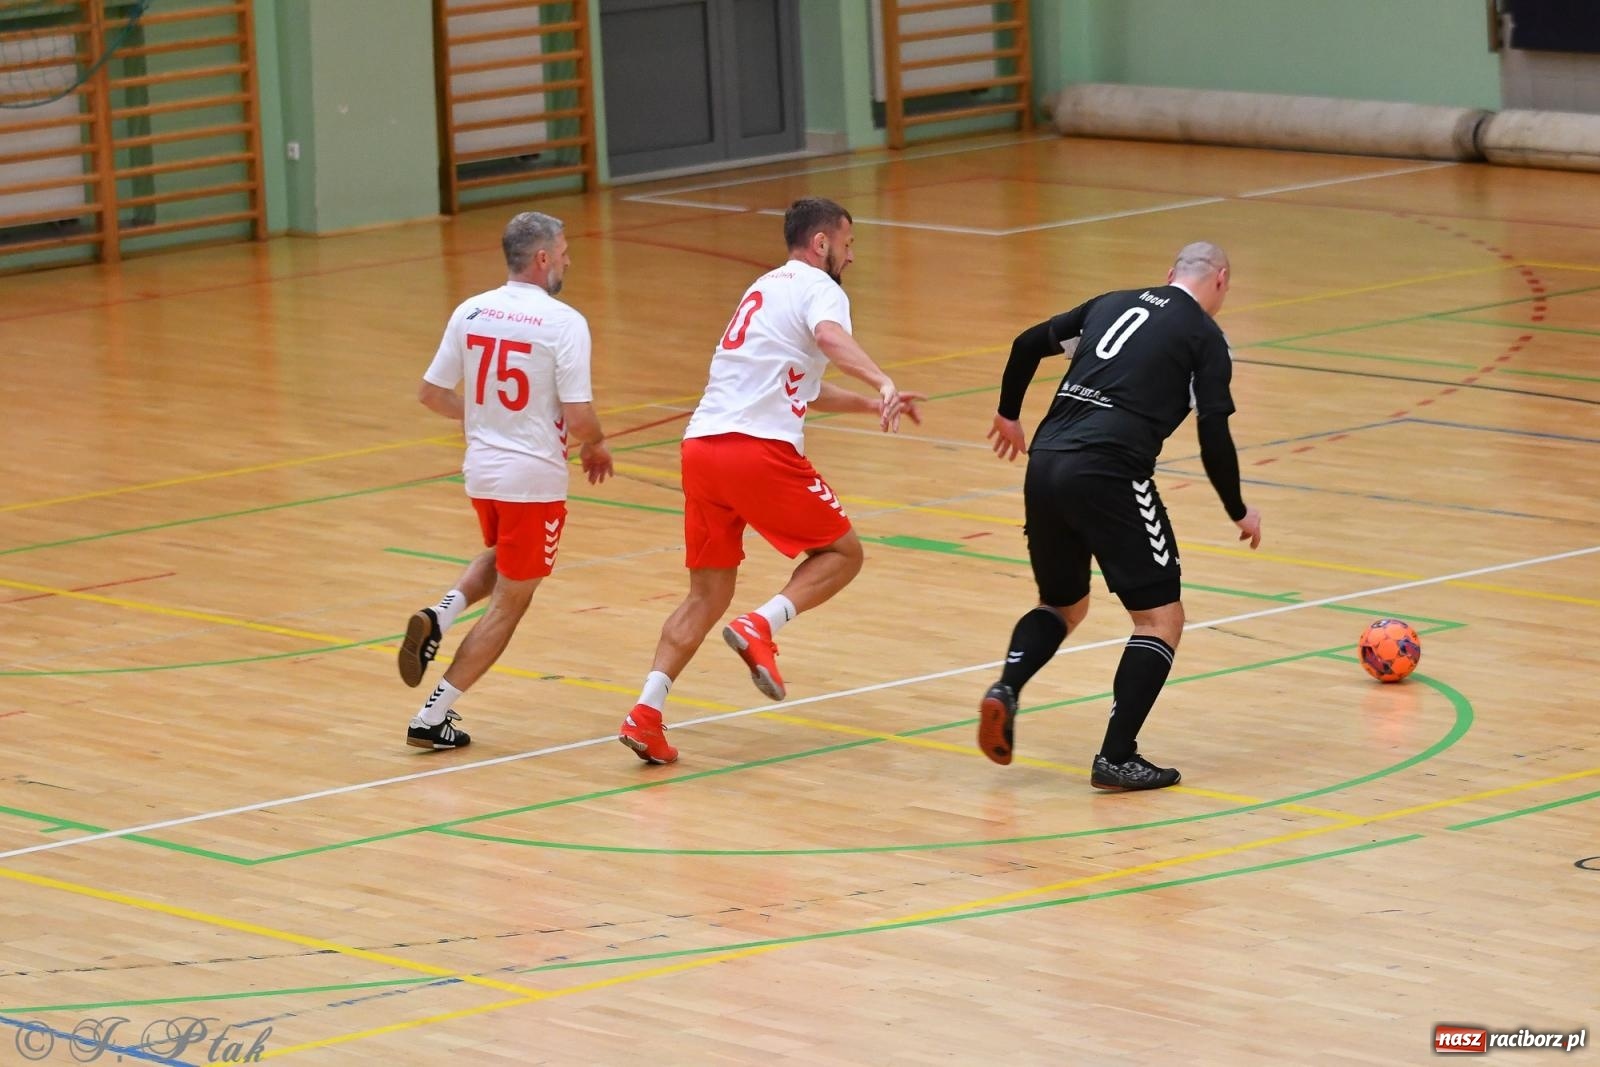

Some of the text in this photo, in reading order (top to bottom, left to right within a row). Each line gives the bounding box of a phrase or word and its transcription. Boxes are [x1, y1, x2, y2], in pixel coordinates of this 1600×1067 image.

[721, 290, 764, 351] 0
[1095, 306, 1150, 360] 0
[466, 333, 532, 412] 75
